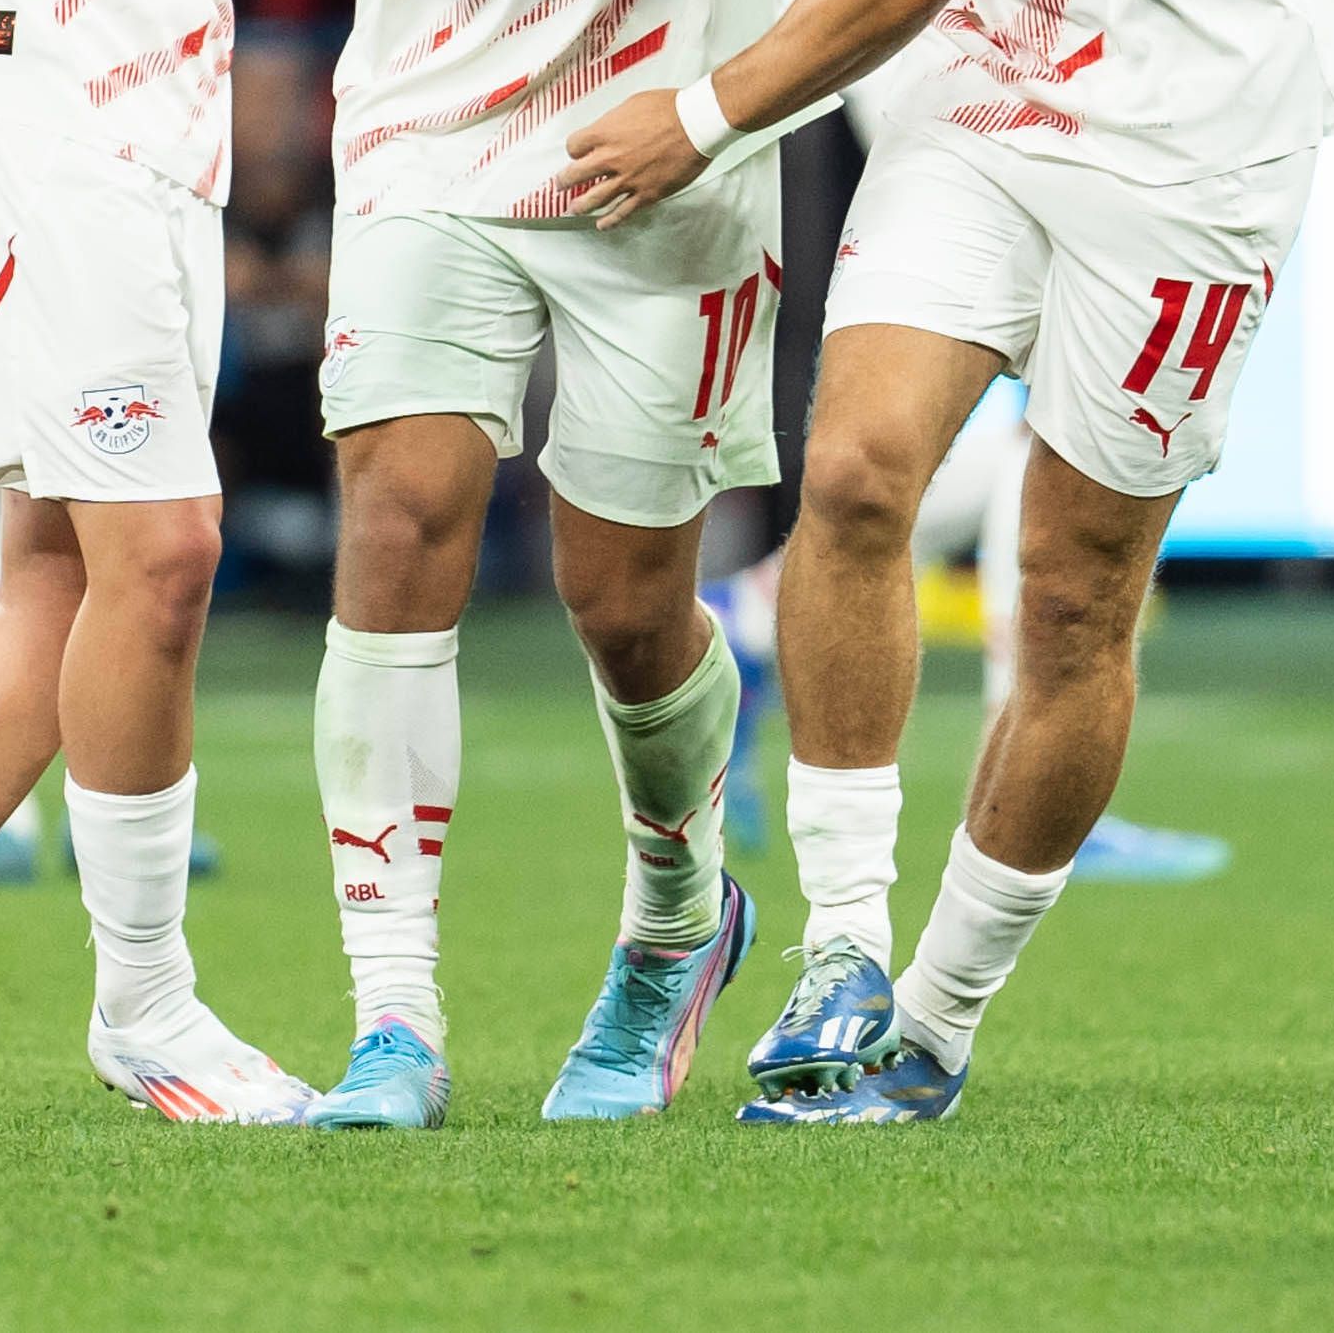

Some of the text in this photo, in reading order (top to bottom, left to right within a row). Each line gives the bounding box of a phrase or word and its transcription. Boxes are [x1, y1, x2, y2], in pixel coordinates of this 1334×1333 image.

[692, 272, 760, 421] 10
[1121, 277, 1253, 401] 14
[344, 881, 386, 903] RBL
